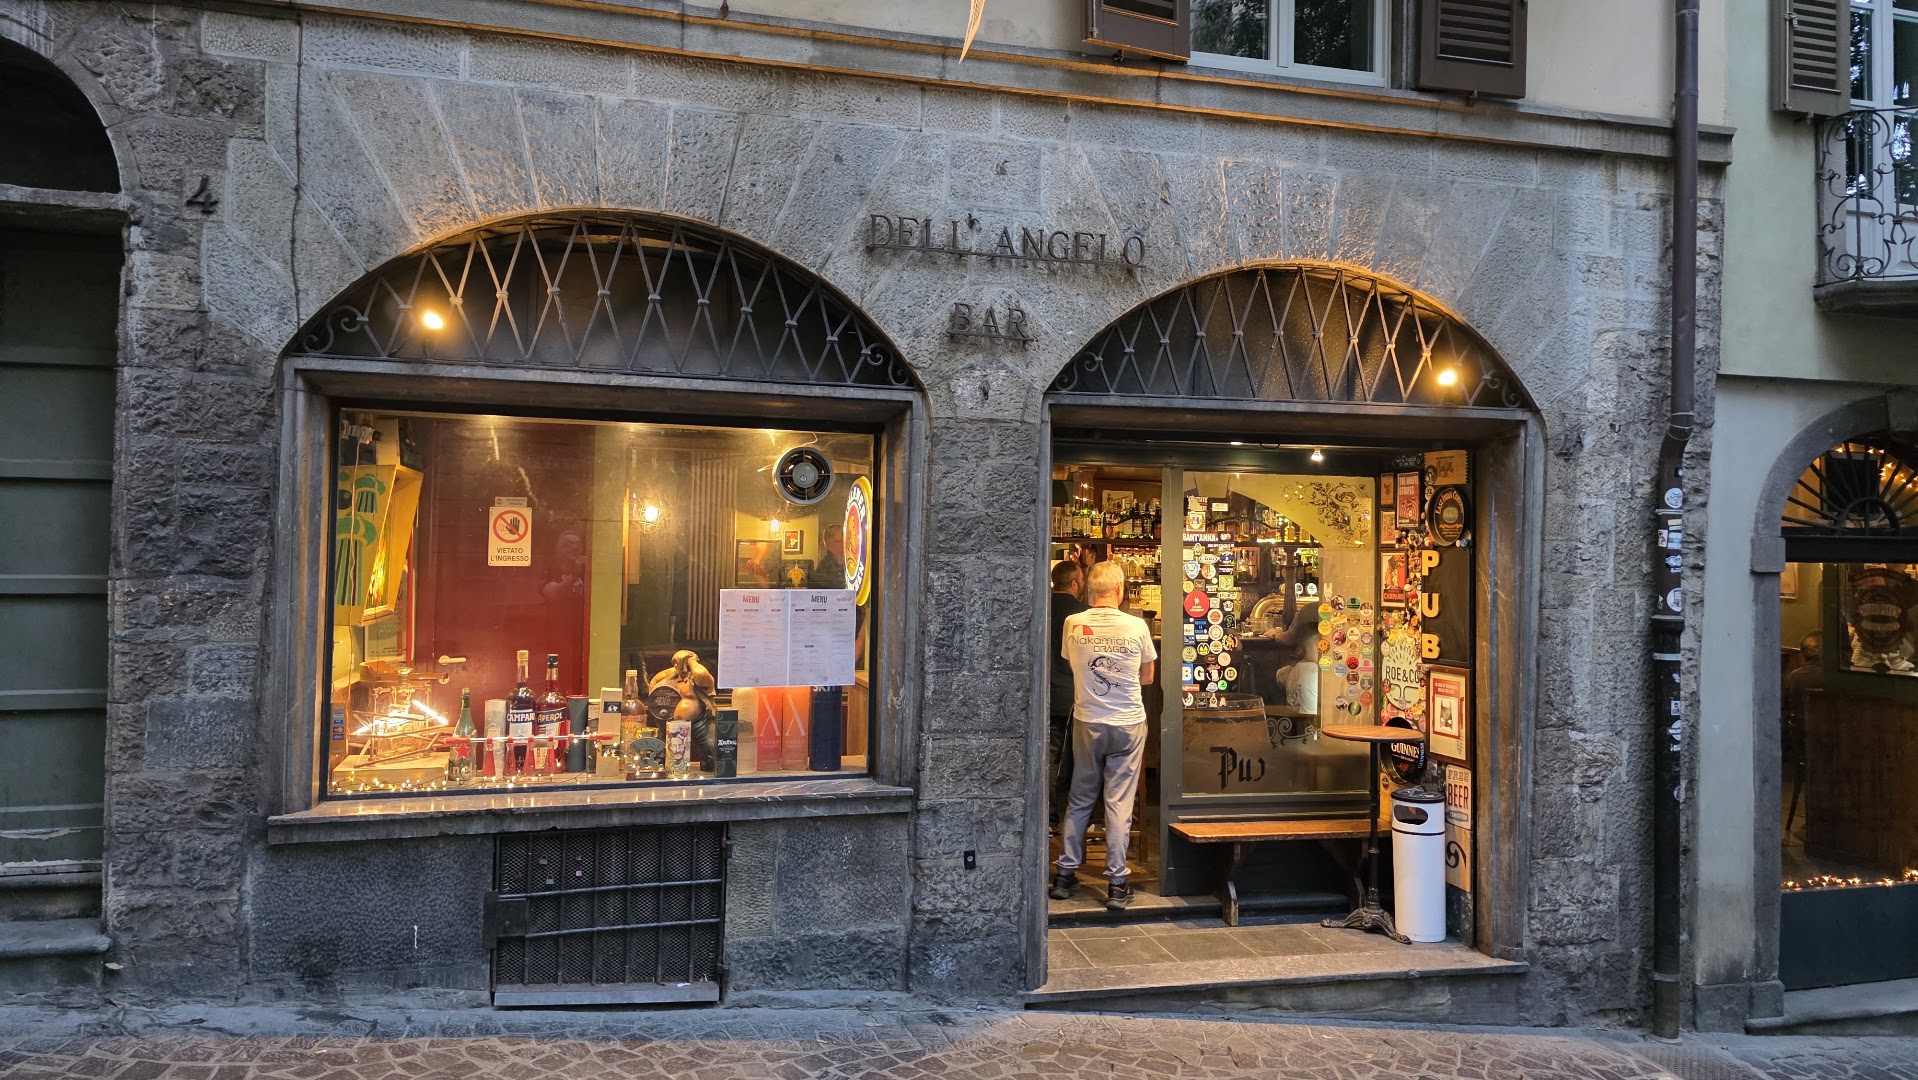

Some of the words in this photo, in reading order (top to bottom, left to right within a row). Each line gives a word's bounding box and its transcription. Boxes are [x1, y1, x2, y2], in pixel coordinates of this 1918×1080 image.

[186, 174, 219, 215] 4
[953, 302, 1029, 339] BAR
[742, 595, 760, 604] MENU
[811, 594, 828, 604] MENU
[1421, 550, 1440, 659] PUB
[1385, 665, 1420, 683] ROE&CO
[537, 711, 563, 723] APEROL
[1447, 769, 1470, 783] FREE
[1447, 783, 1469, 810] BEER
